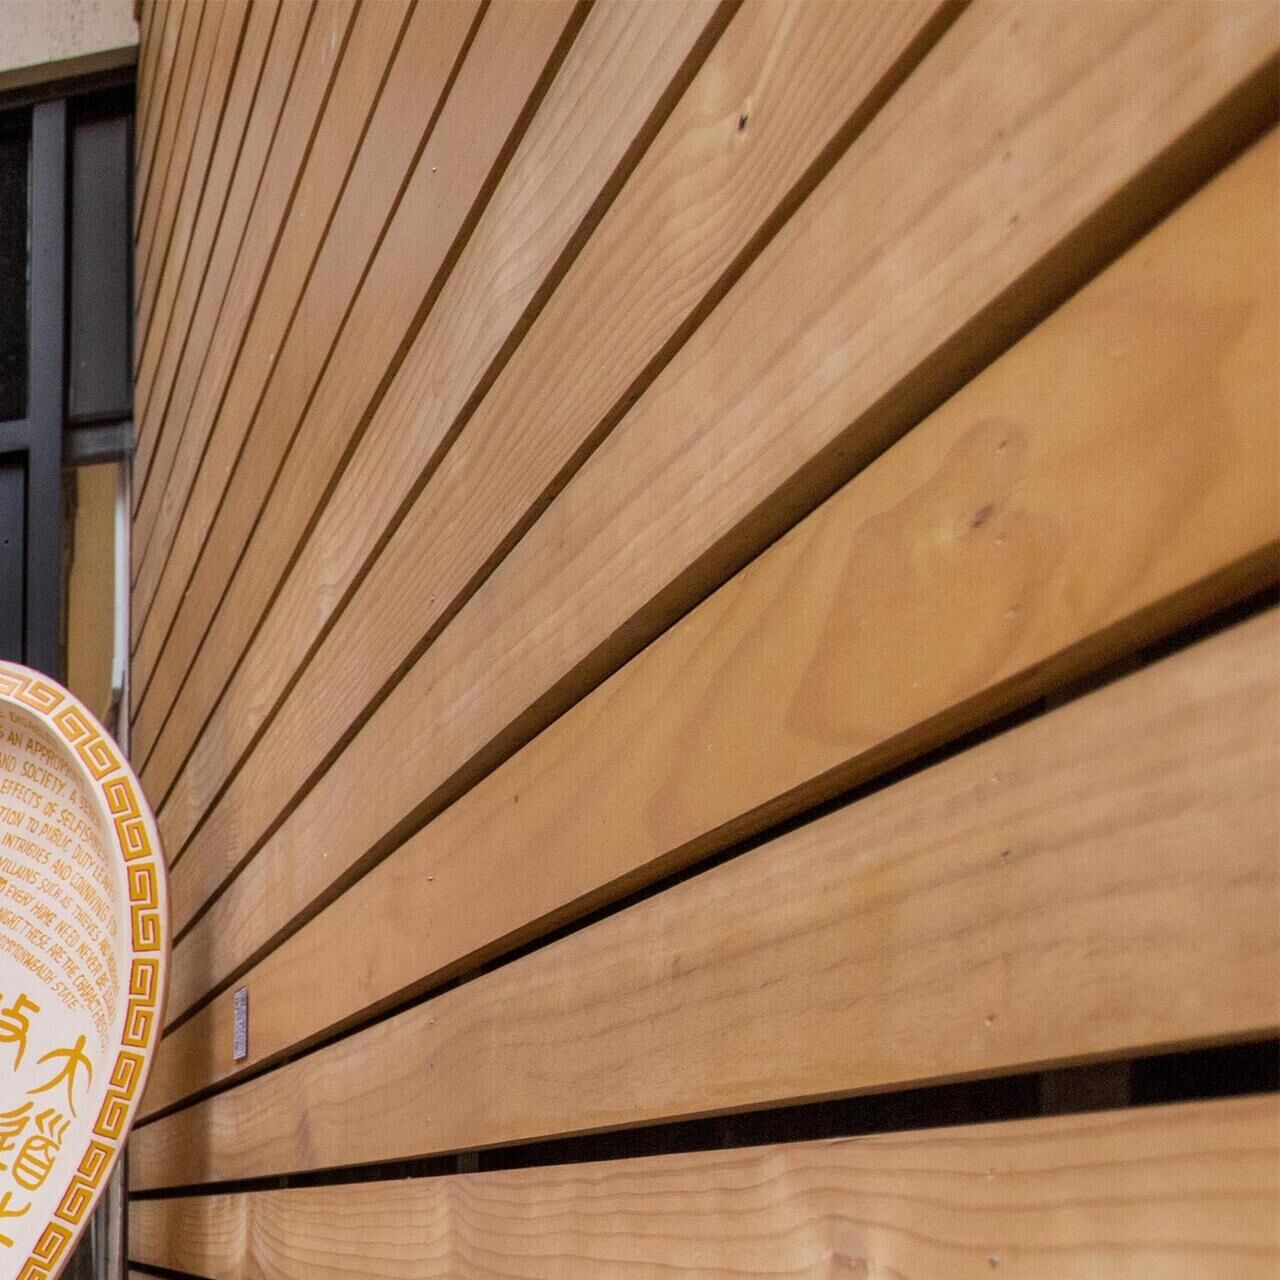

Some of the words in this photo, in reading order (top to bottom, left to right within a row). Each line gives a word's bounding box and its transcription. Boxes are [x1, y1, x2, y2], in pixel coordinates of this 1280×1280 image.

[8, 732, 22, 747] AN
[0, 779, 43, 808] EFFECTS
[43, 801, 58, 816] OF
[70, 789, 77, 803] A
[1, 832, 52, 864] INTRIGUES
[51, 859, 72, 880] AND
[28, 816, 40, 833] TO
[39, 823, 72, 852] PUBLIC
[72, 844, 96, 874] DUTY
[3, 881, 35, 906] EVERY
[30, 901, 57, 928] HOME
[55, 920, 80, 948] NEED
[76, 942, 103, 978] NEVER
[95, 972, 109, 989] BE
[38, 878, 64, 903] SUCH
[60, 895, 73, 908] AS
[71, 904, 102, 942] THIEVES
[21, 919, 52, 950] THESE
[47, 943, 65, 964] ARE
[60, 956, 80, 978] THE
